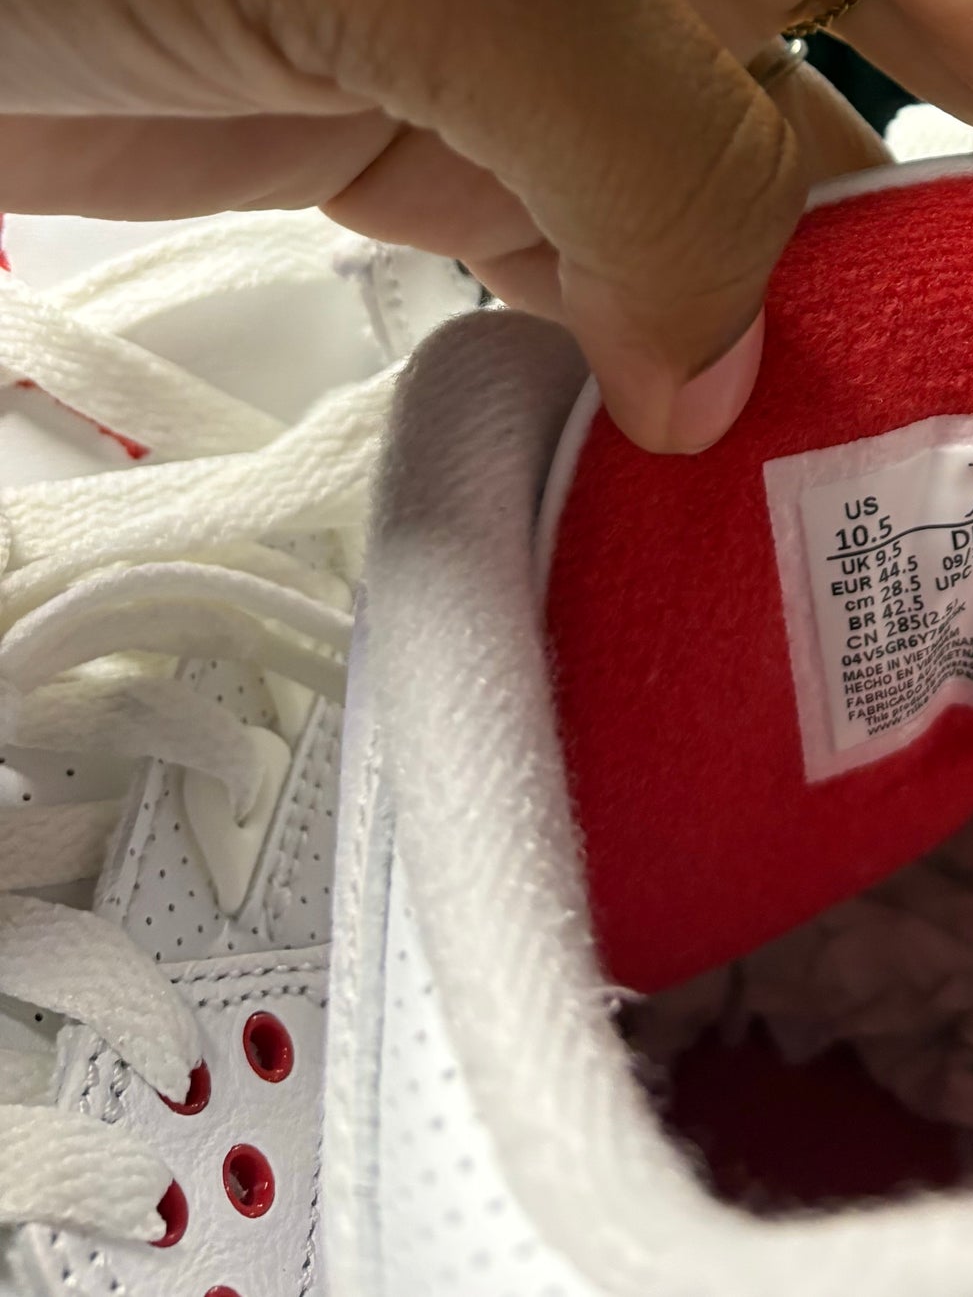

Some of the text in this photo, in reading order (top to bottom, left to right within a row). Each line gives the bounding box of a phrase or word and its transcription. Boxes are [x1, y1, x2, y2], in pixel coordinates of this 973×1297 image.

[845, 496, 879, 520] US
[835, 515, 893, 551] 10.5
[842, 540, 902, 575] UK 9.5
[831, 555, 918, 596] EUR 44.5
[935, 565, 972, 591] UPC
[845, 575, 921, 612] cm 28.5
[848, 595, 924, 630] BR 42.5
[847, 630, 878, 649] CN
[843, 664, 883, 682] MADE
[887, 657, 900, 671] IN
[844, 674, 892, 694] HECHO
[897, 666, 913, 681] EN
[847, 679, 913, 708] FABRIQUE
[848, 684, 922, 721] FABRICADO
